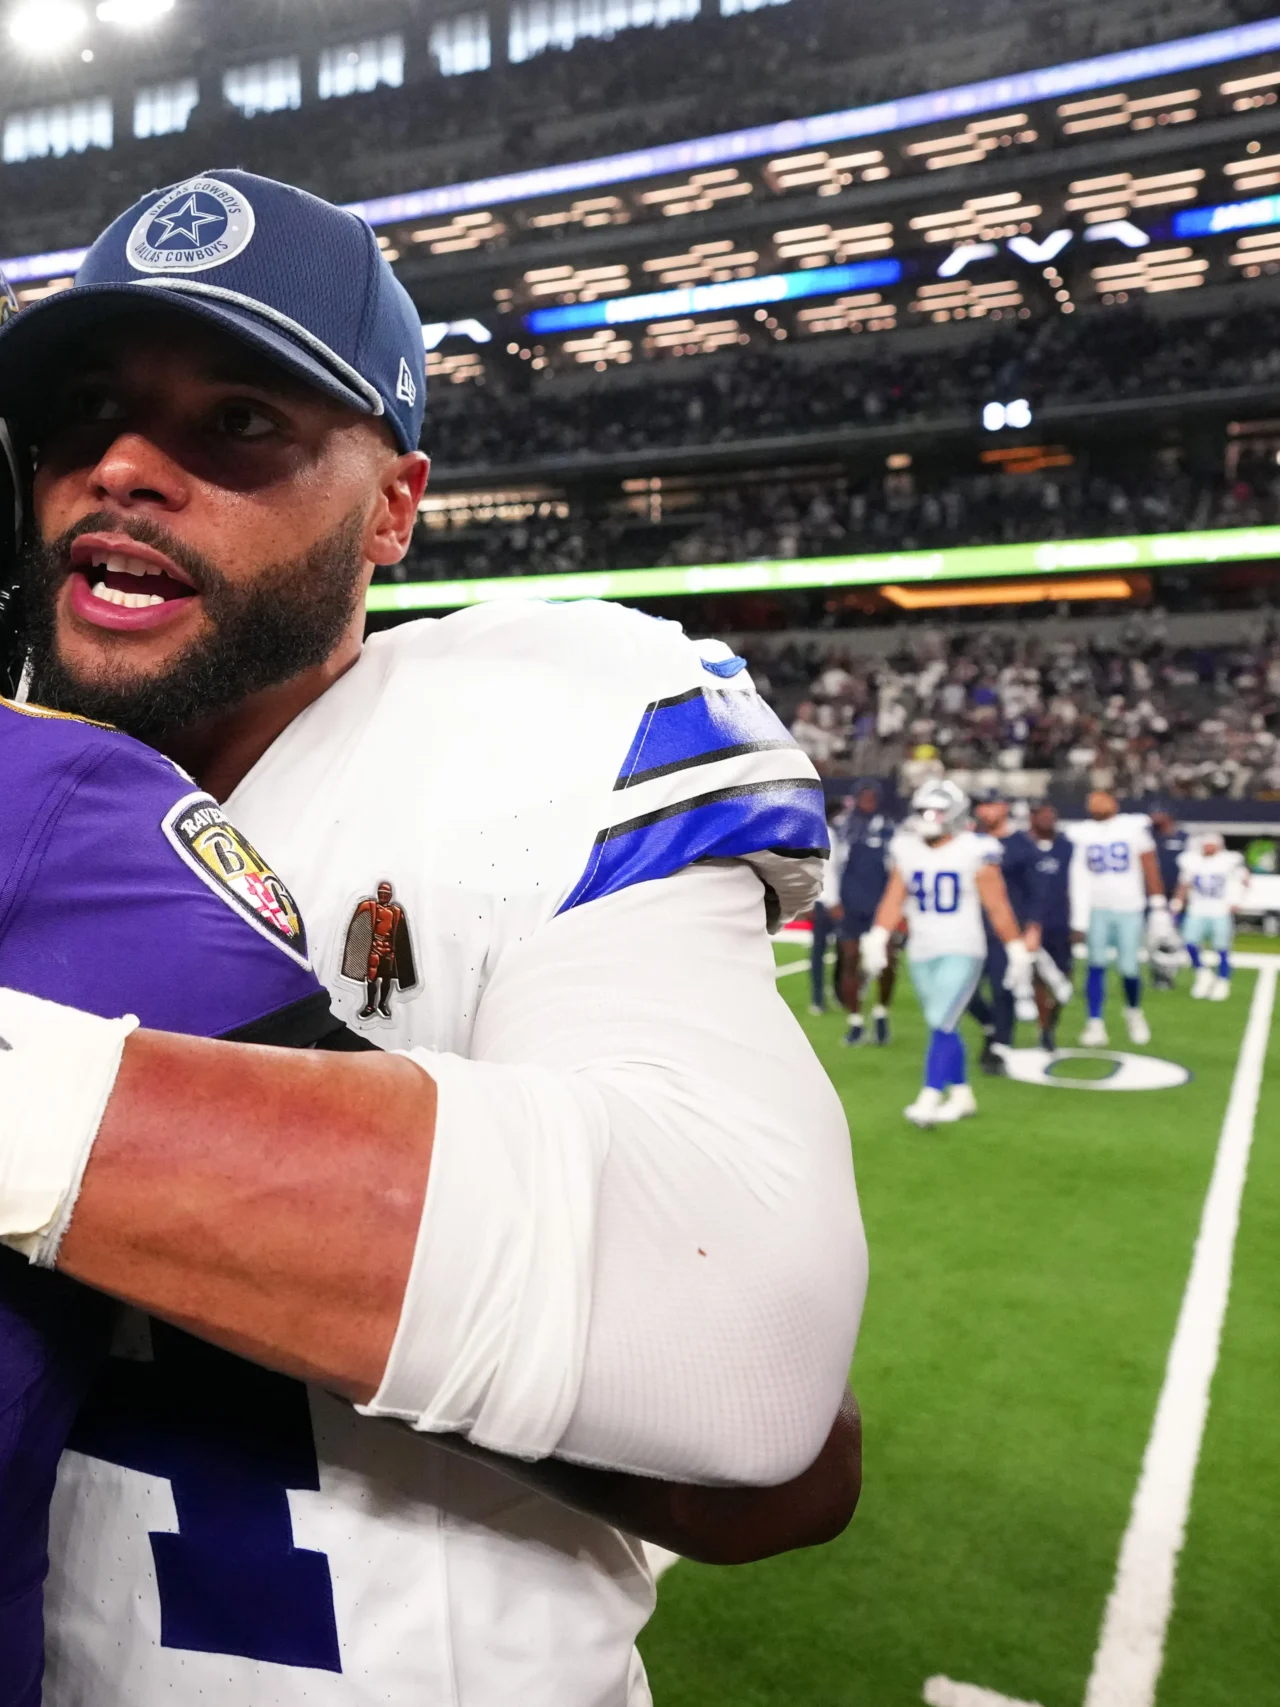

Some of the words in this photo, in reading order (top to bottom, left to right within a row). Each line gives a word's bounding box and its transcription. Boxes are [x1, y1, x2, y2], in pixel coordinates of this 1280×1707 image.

[150, 186, 189, 216] DALLAS
[193, 182, 242, 214] COWBOYS
[134, 241, 163, 263] DALLAS
[165, 240, 229, 262] COWBOYS
[907, 871, 959, 912] 40
